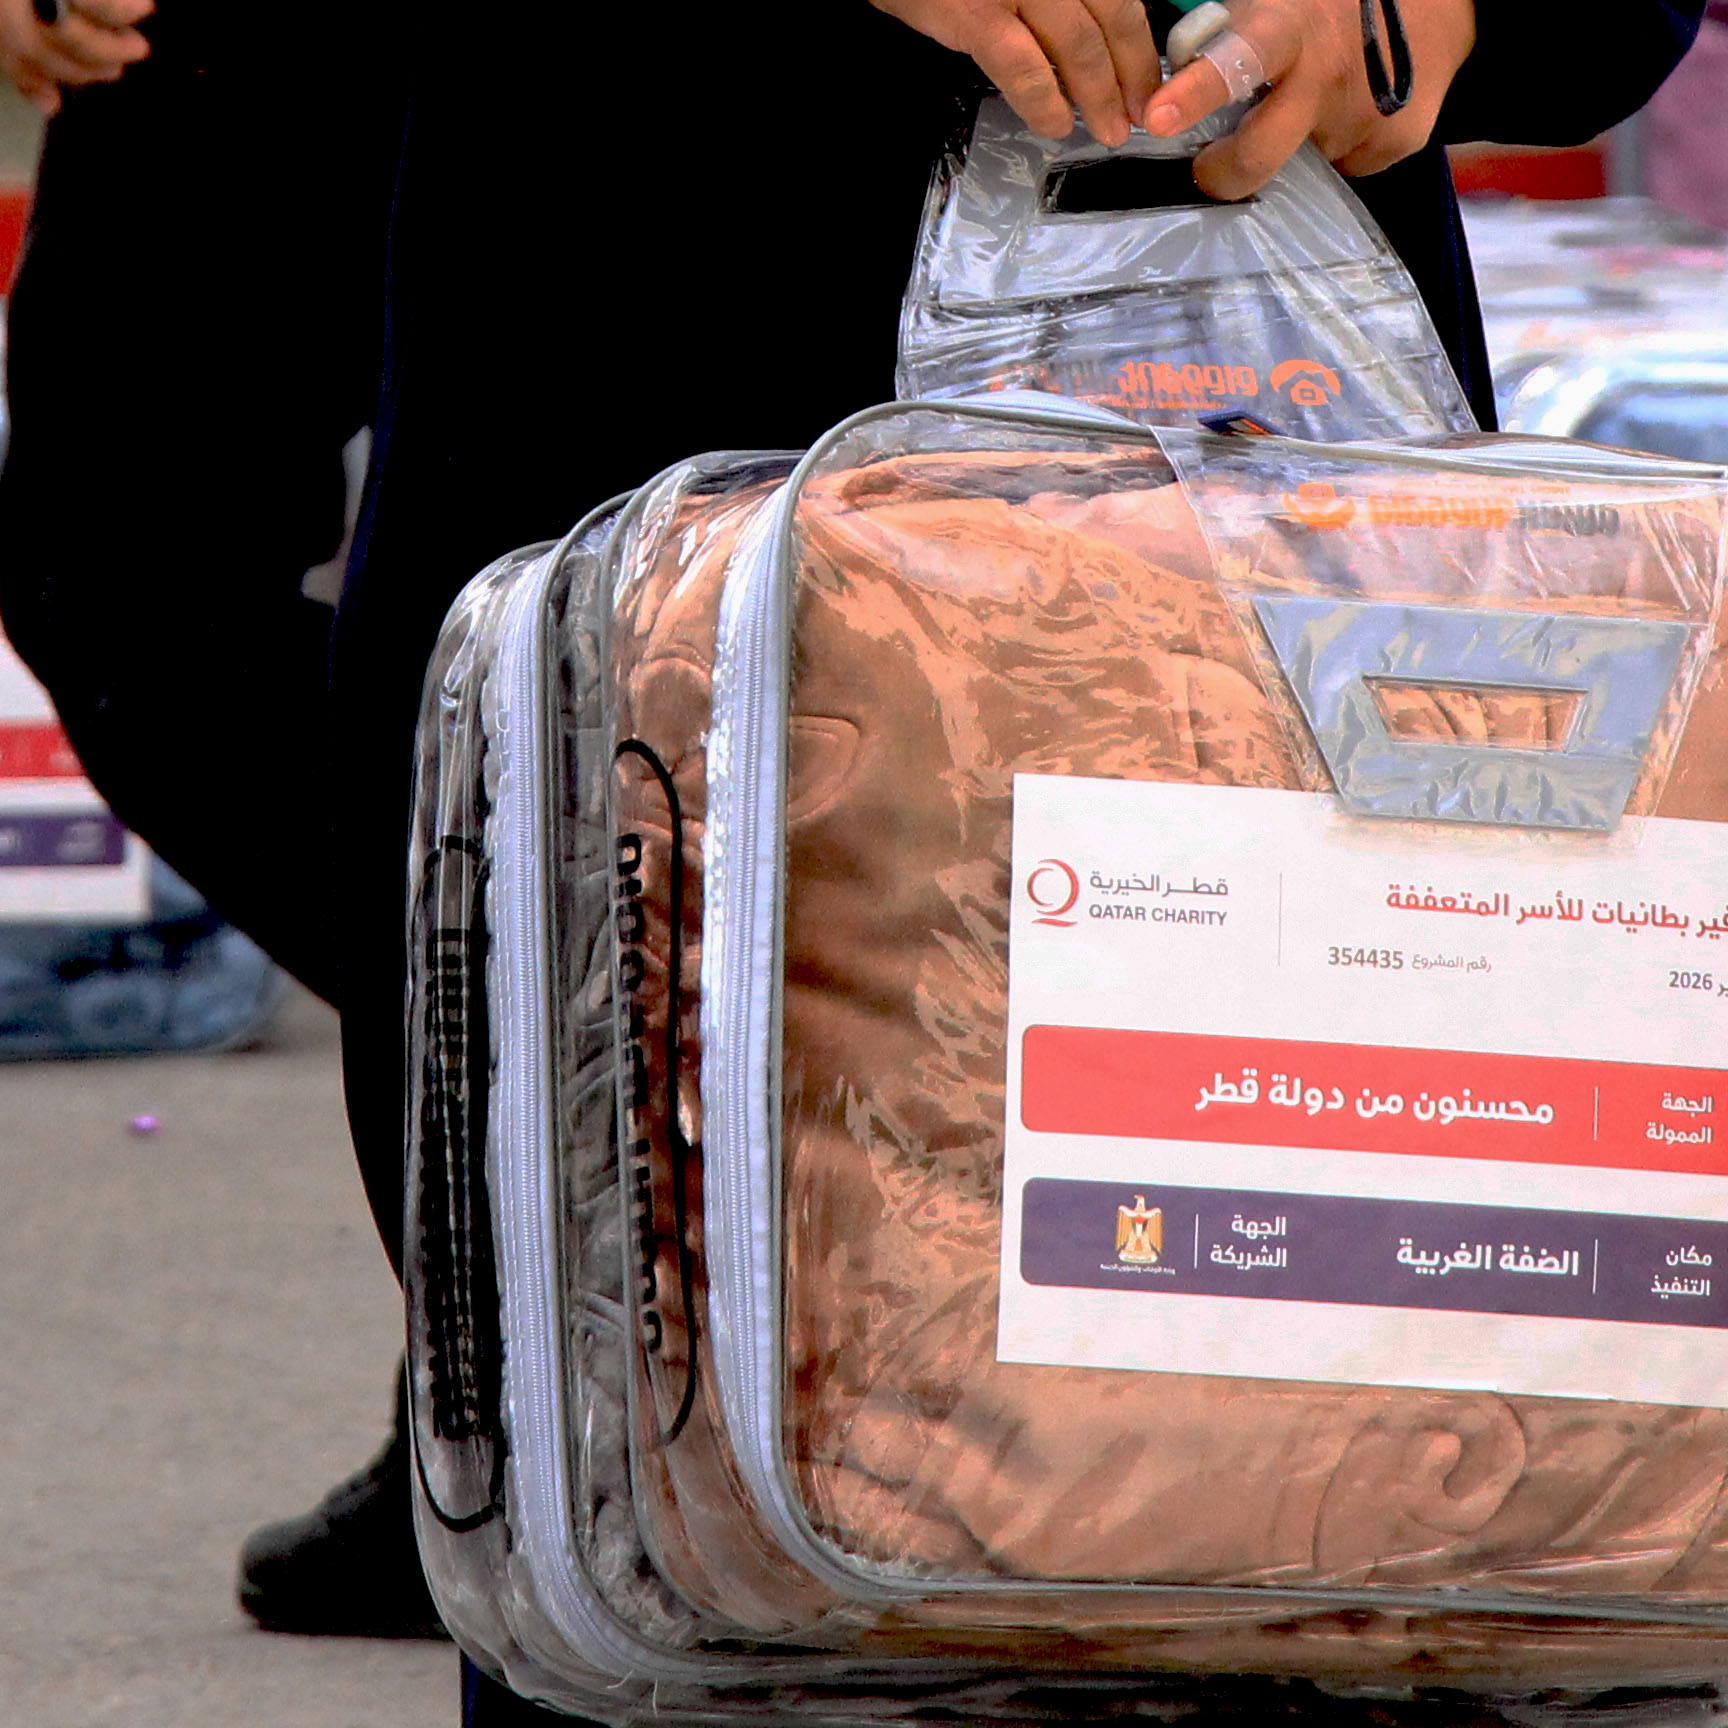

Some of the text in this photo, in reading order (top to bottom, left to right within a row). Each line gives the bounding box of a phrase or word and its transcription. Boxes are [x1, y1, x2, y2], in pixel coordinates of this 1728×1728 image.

[1089, 870, 1229, 898] قطر الخيرية
[1385, 882, 1510, 918] المتعففة
[1516, 890, 1584, 926] للأسر
[1088, 903, 1228, 926] QATAR CHARITY
[1591, 900, 1690, 936] بطانيات
[1327, 945, 1492, 974] رقم المشروع 354435
[1669, 970, 1714, 992] 2026
[1194, 1068, 1555, 1126] محسنون من دولة قطر
[1661, 1091, 1714, 1119] الجهة
[1645, 1121, 1713, 1146] الممولة
[1230, 1213, 1288, 1241] الجهة
[1209, 1243, 1288, 1271] الشريكة
[1395, 1236, 1580, 1277] الضفة الغربية
[1665, 1245, 1714, 1268] مكان
[1650, 1273, 1712, 1300] التنفيذ
